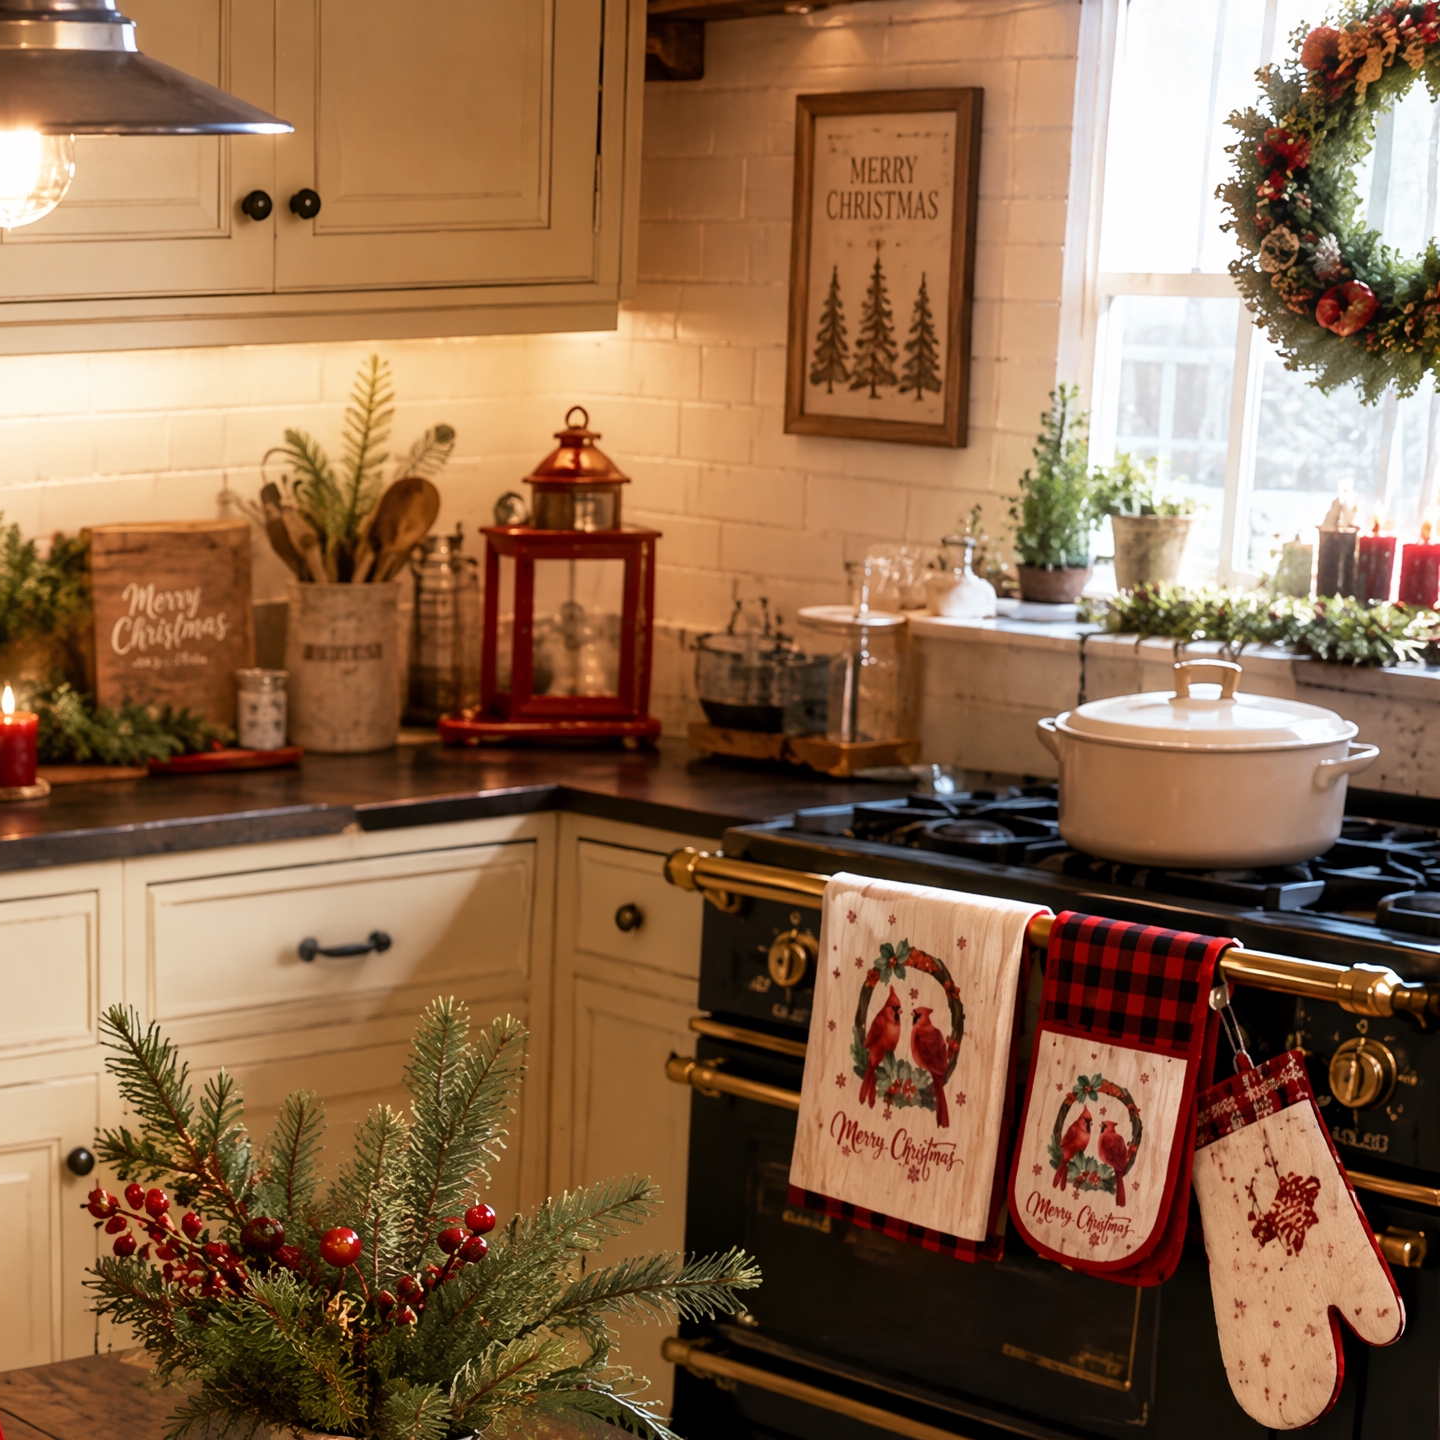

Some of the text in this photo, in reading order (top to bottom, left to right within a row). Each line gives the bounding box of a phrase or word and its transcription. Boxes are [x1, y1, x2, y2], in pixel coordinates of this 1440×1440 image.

[850, 155, 918, 184] MERRY
[826, 189, 939, 220] CHRISTMAS
[121, 581, 202, 620] Merry
[110, 611, 234, 656] Christmas
[830, 1110, 965, 1182] Merry Christmas
[1026, 1190, 1136, 1245] Merry Christmas
